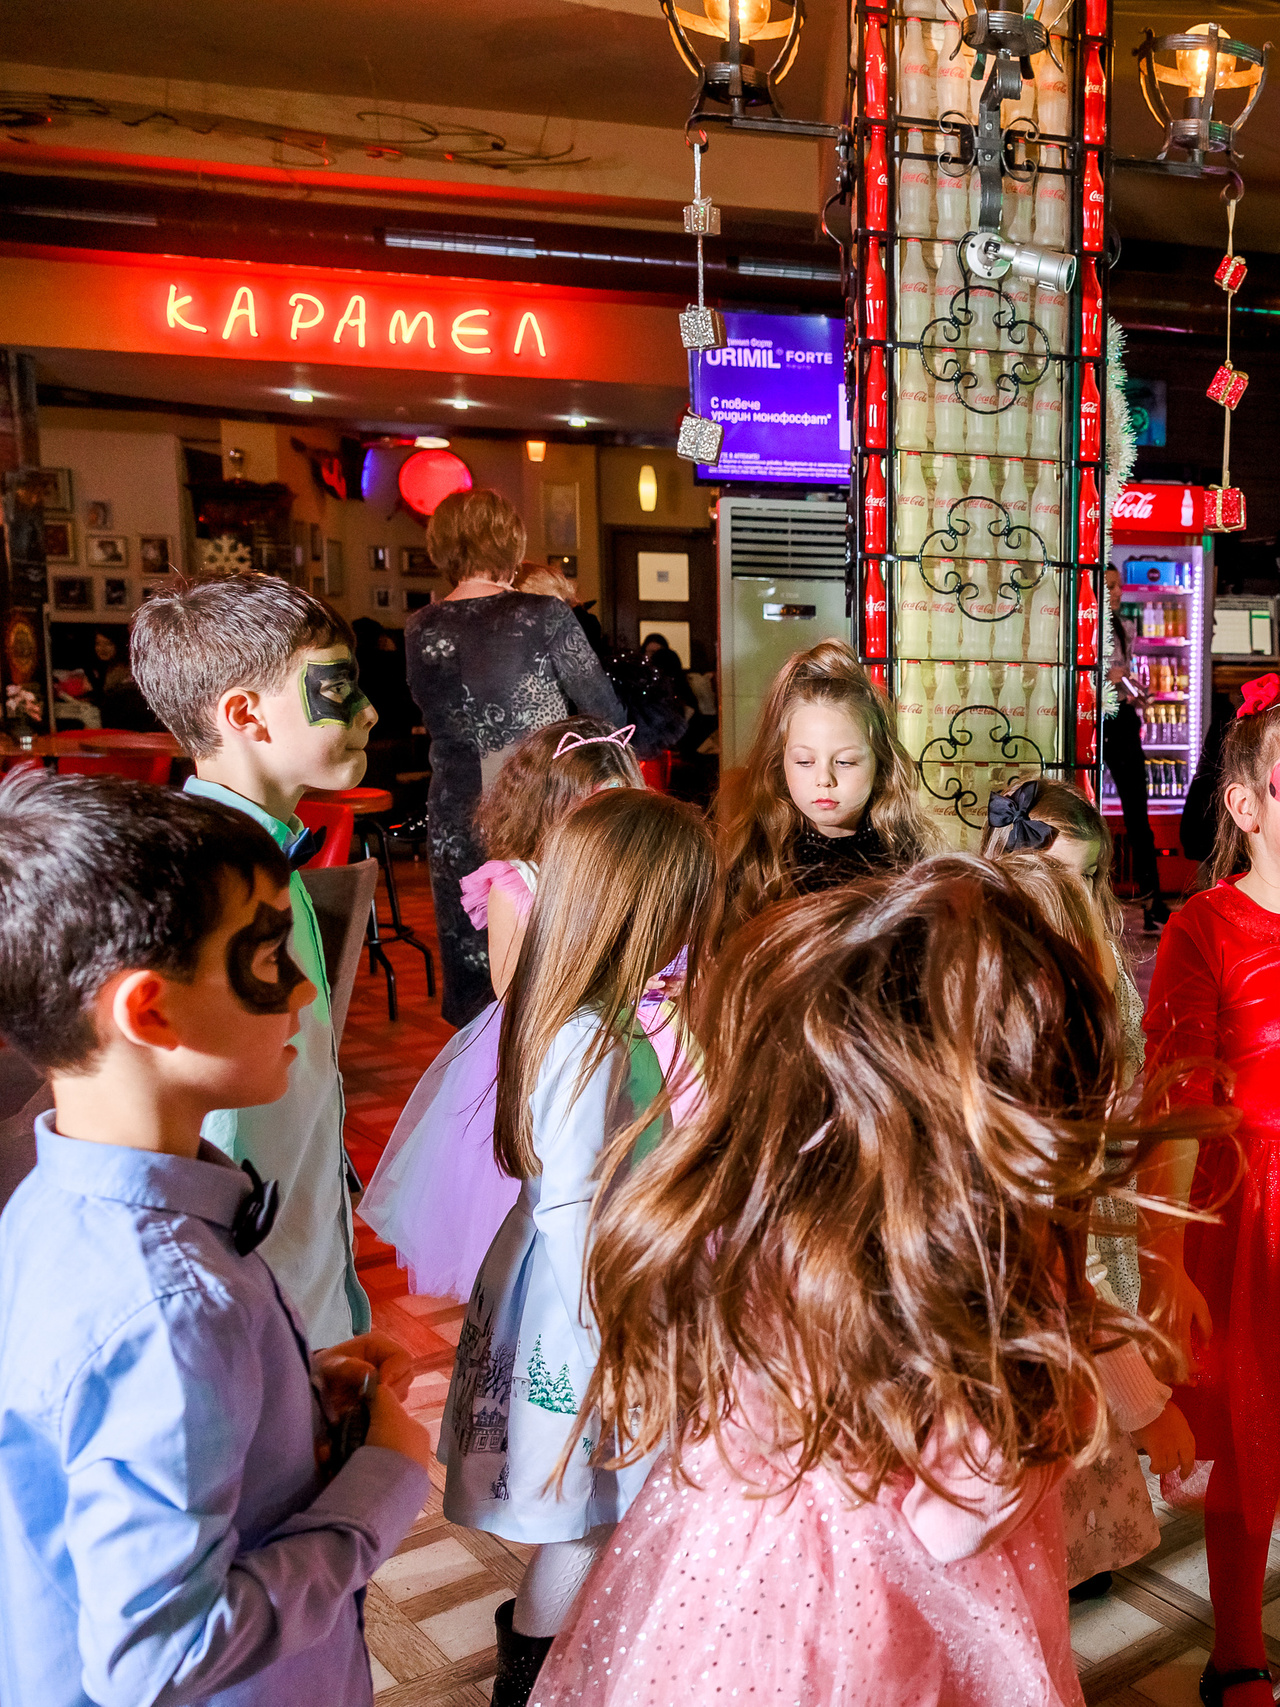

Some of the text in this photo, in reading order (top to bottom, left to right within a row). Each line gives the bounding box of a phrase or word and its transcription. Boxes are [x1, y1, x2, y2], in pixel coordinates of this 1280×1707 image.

[166, 283, 547, 358] КАРАМЕЛ
[706, 346, 833, 369] URIMIL FORTE
[721, 398, 761, 411] повече
